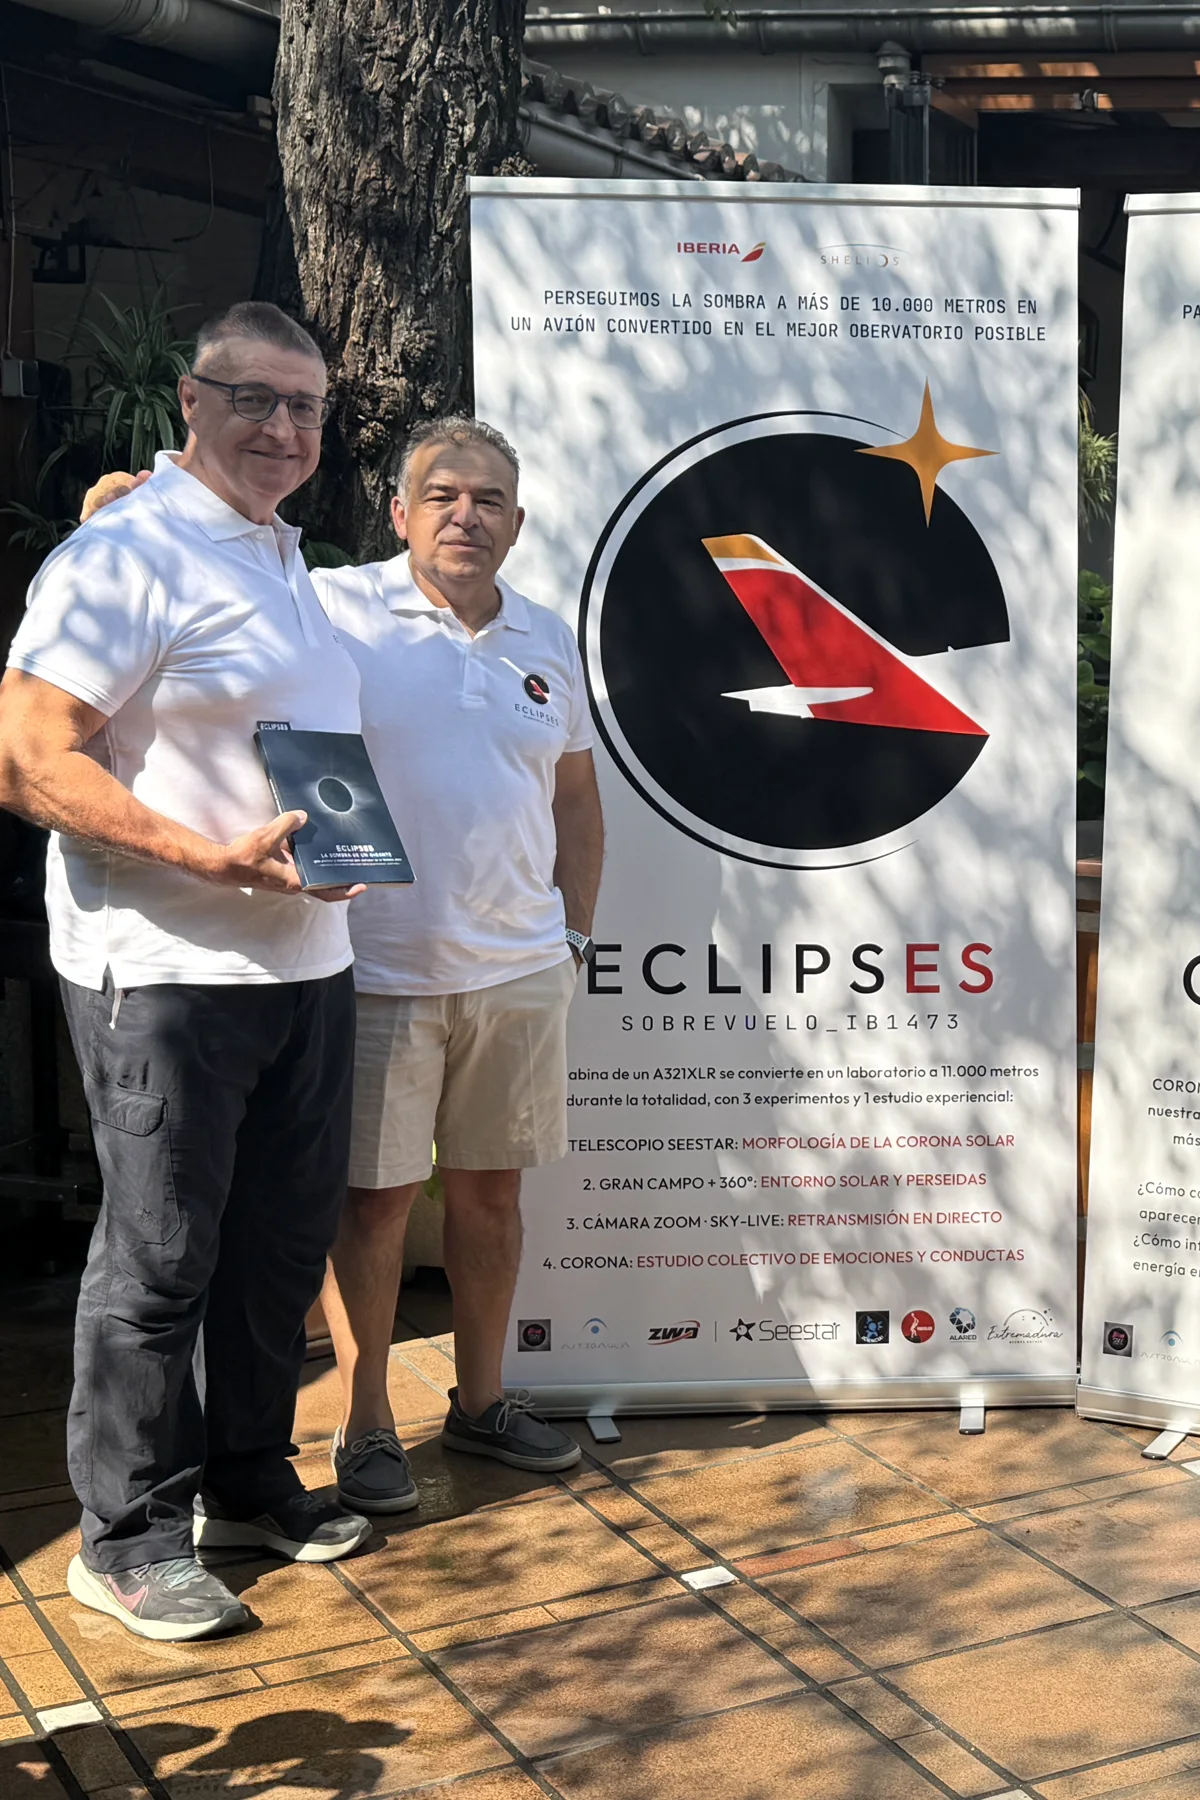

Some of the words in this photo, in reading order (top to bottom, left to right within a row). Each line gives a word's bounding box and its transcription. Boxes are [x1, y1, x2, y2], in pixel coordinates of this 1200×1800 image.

[677, 242, 740, 255] IBERIA
[544, 290, 661, 307] PERSEGUIMOS
[672, 293, 692, 308] LA
[703, 293, 766, 309] SOMBRA
[777, 295, 787, 310] A
[798, 292, 829, 311] MÁS
[840, 296, 860, 311] DE
[872, 297, 934, 313] 10.000
[944, 298, 1006, 314] METROS
[1017, 299, 1037, 315] EN
[511, 316, 531, 331] UN
[543, 314, 595, 333] AVIÓN
[607, 318, 712, 335] CONVERTIDO
[724, 321, 744, 336] EN
[755, 321, 775, 337] EL
[786, 322, 838, 338] MEJOR
[850, 323, 963, 340] OBERVATORIO
[975, 326, 1046, 341] POSIBLE
[514, 703, 560, 727] ECLIPSES
[587, 942, 995, 996] ECLIPSES
[621, 1012, 961, 1034] SOBREVUELO_IB1473
[568, 1067, 609, 1081] abina
[612, 1067, 630, 1081] de
[633, 1070, 650, 1080] un
[653, 1067, 716, 1080] A321XLR
[719, 1069, 735, 1080] se
[737, 1066, 804, 1080] convierte
[807, 1068, 824, 1079] en
[827, 1068, 844, 1079] un
[846, 1066, 926, 1079] laboratorio
[929, 1068, 938, 1078] a
[941, 1065, 987, 1078] 11.000
[989, 1066, 1039, 1078] metros
[566, 1094, 623, 1107] durante
[626, 1093, 638, 1107] la
[641, 1093, 711, 1108] totalidad,
[714, 1094, 740, 1105] con
[742, 1092, 752, 1105] 3
[754, 1091, 850, 1107] experimentos
[853, 1094, 861, 1107] y
[863, 1091, 870, 1104] 1
[872, 1091, 923, 1104] estudio
[926, 1089, 1014, 1106] experiencial:
[567, 1138, 664, 1152] TELESCOPIO
[667, 1137, 739, 1151] SEESTAR:
[742, 1133, 846, 1150] MORFOLOGÍA
[850, 1136, 870, 1149] DE
[873, 1135, 892, 1149] LA
[896, 1134, 963, 1149] CORONA
[965, 1134, 1015, 1148] SOLAR
[1172, 1132, 1200, 1148] más
[582, 1178, 596, 1191] 2.
[599, 1177, 644, 1191] GRAN
[647, 1176, 704, 1190] CAMPO
[761, 1175, 836, 1188] ENTORNO
[839, 1174, 889, 1187] SOLAR
[892, 1174, 903, 1187] Y
[906, 1173, 987, 1187] PERSEIDAS
[1137, 1181, 1186, 1198] ¿Cómo
[566, 1217, 579, 1231] 3.
[583, 1213, 650, 1230] CÁMARA
[653, 1215, 701, 1229] ZOOM
[788, 1209, 909, 1227] RETRANSMISIÓN
[913, 1212, 933, 1225] EN
[936, 1210, 1003, 1224] DIRECTO
[1133, 1232, 1181, 1250] ¿Cómo
[542, 1257, 557, 1270] 4.
[560, 1255, 634, 1270] CORONA:
[637, 1254, 704, 1268] ESTUDIO
[707, 1252, 796, 1267] COLECTIVO
[800, 1252, 820, 1265] DE
[823, 1250, 913, 1265] EMOCIONES
[916, 1250, 926, 1263] Y
[930, 1248, 1025, 1264] CONDUCTAS
[1132, 1257, 1186, 1277] energía
[758, 1320, 841, 1342] Seestar
[987, 1324, 1063, 1341] Extremadura
